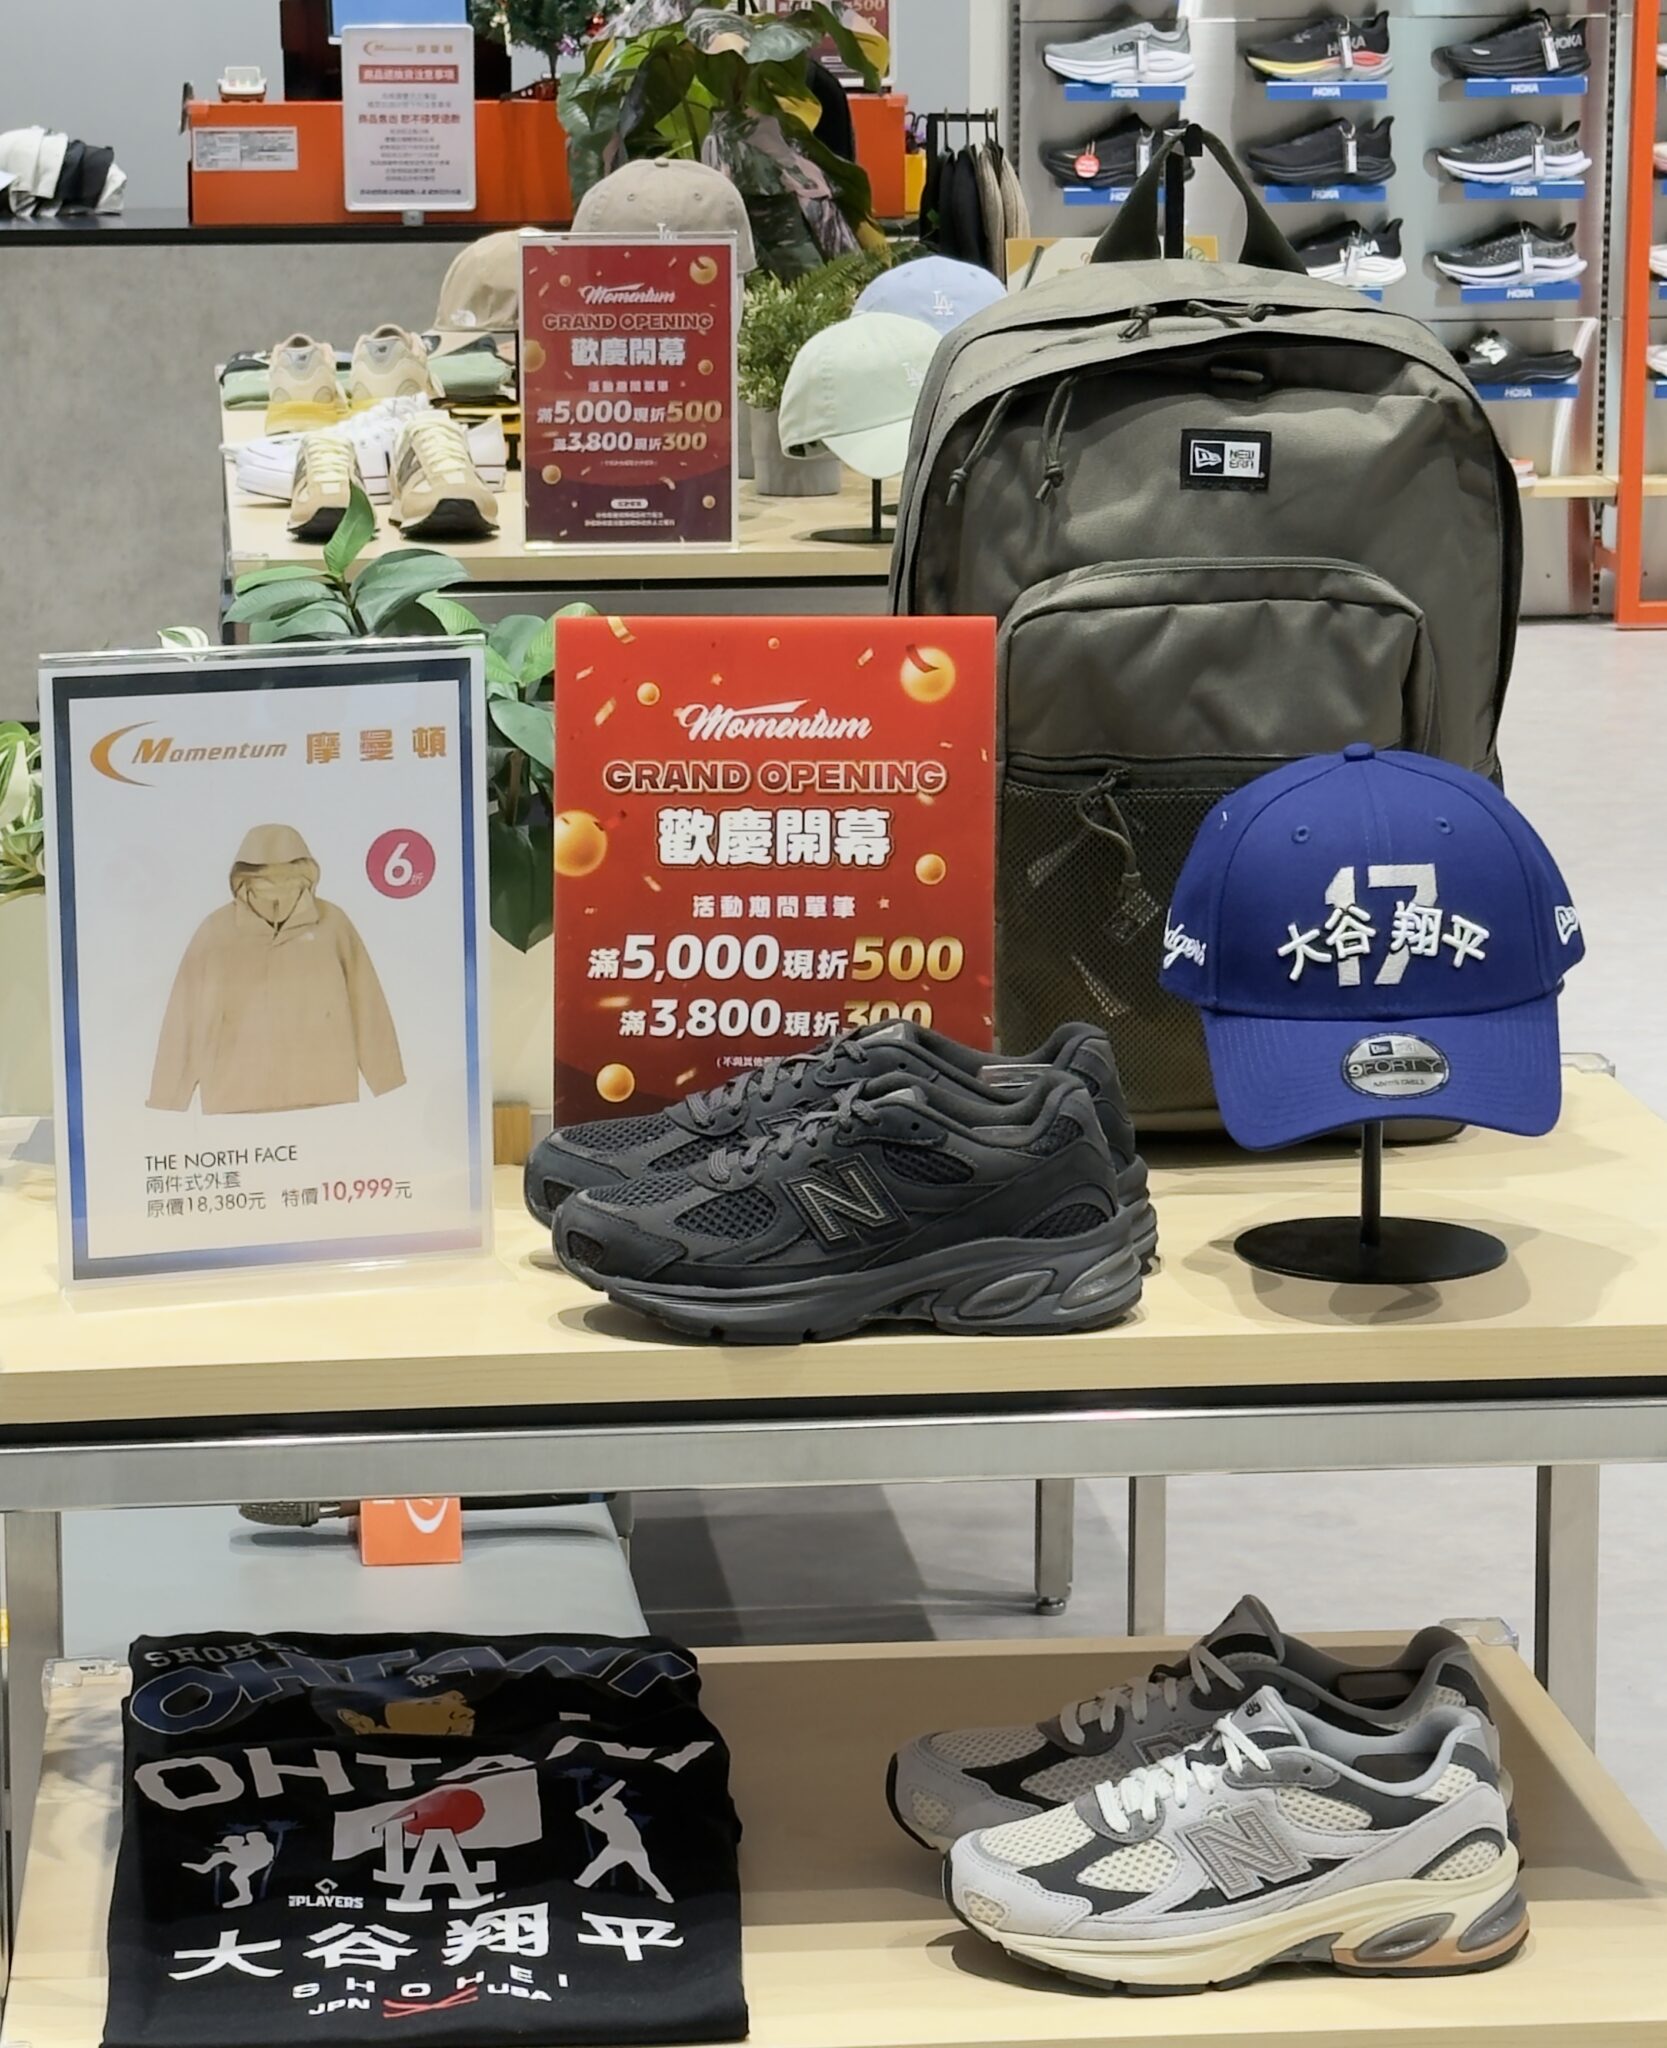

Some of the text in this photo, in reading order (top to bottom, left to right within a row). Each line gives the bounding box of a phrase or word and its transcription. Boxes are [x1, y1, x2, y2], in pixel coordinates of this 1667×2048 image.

[1327, 35, 1367, 57] HKA
[1552, 34, 1583, 51] HOKA
[1111, 87, 1140, 98] HOKA
[1312, 87, 1341, 97] HOKA
[1511, 83, 1540, 94] HOKA
[1311, 189, 1340, 199] HOKA
[1510, 186, 1539, 197] HOKA
[1339, 239, 1381, 263] HKA
[578, 282, 676, 305] Momentum
[932, 290, 954, 316] LA
[1506, 288, 1535, 299] HOKA
[543, 312, 714, 331] GRAND OPENING
[571, 337, 686, 366] 歡慶開幕
[1504, 388, 1533, 398] HOKA
[676, 698, 873, 742] Momentum
[131, 736, 288, 764] Momentum
[603, 760, 948, 795] GRAND OPENING
[656, 806, 893, 868] 歡慶開幕
[692, 893, 857, 920] 活動期間單筆
[1325, 863, 1439, 988] 17
[1277, 900, 1491, 982] 大谷翔平
[1348, 1059, 1442, 1079] 9FORTY
[145, 1145, 298, 1172] THE NORTH FACE
[145, 1171, 241, 1195] 兩件式外套
[147, 1177, 413, 1218] 原價18,380元 特價10,999元
[372, 1811, 498, 1912] LA
[168, 1902, 684, 1981] 大谷翔平
[292, 1964, 569, 1999] SHOHEI
[308, 1983, 552, 2016] JPN USA
